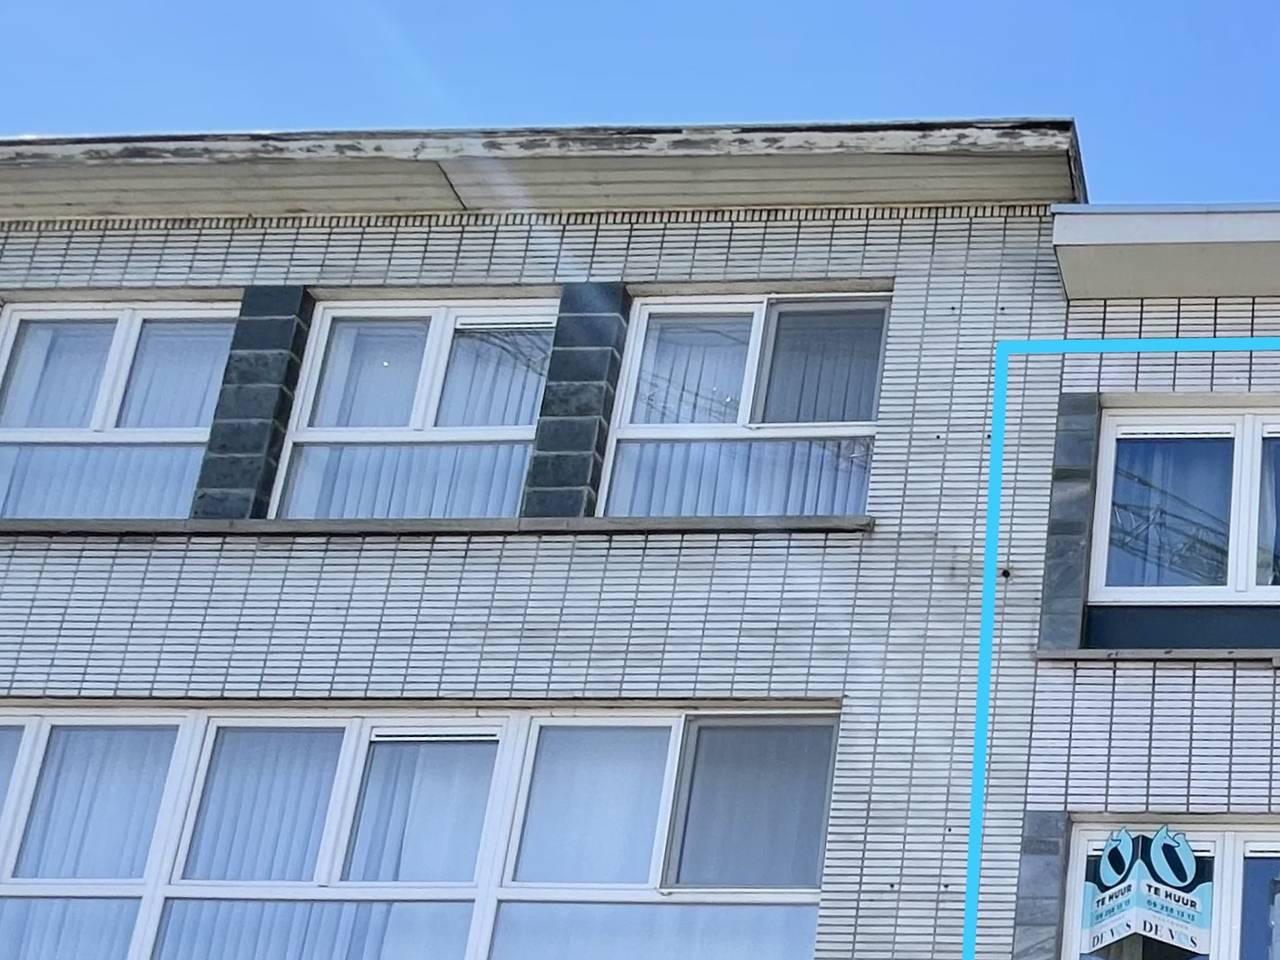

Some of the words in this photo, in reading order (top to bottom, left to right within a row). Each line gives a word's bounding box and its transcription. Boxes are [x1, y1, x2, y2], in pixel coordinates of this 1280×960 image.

[1096, 897, 1106, 908] TE
[1108, 884, 1132, 904] HUUR
[1146, 883, 1160, 896] TE
[1164, 890, 1198, 909] HUUR
